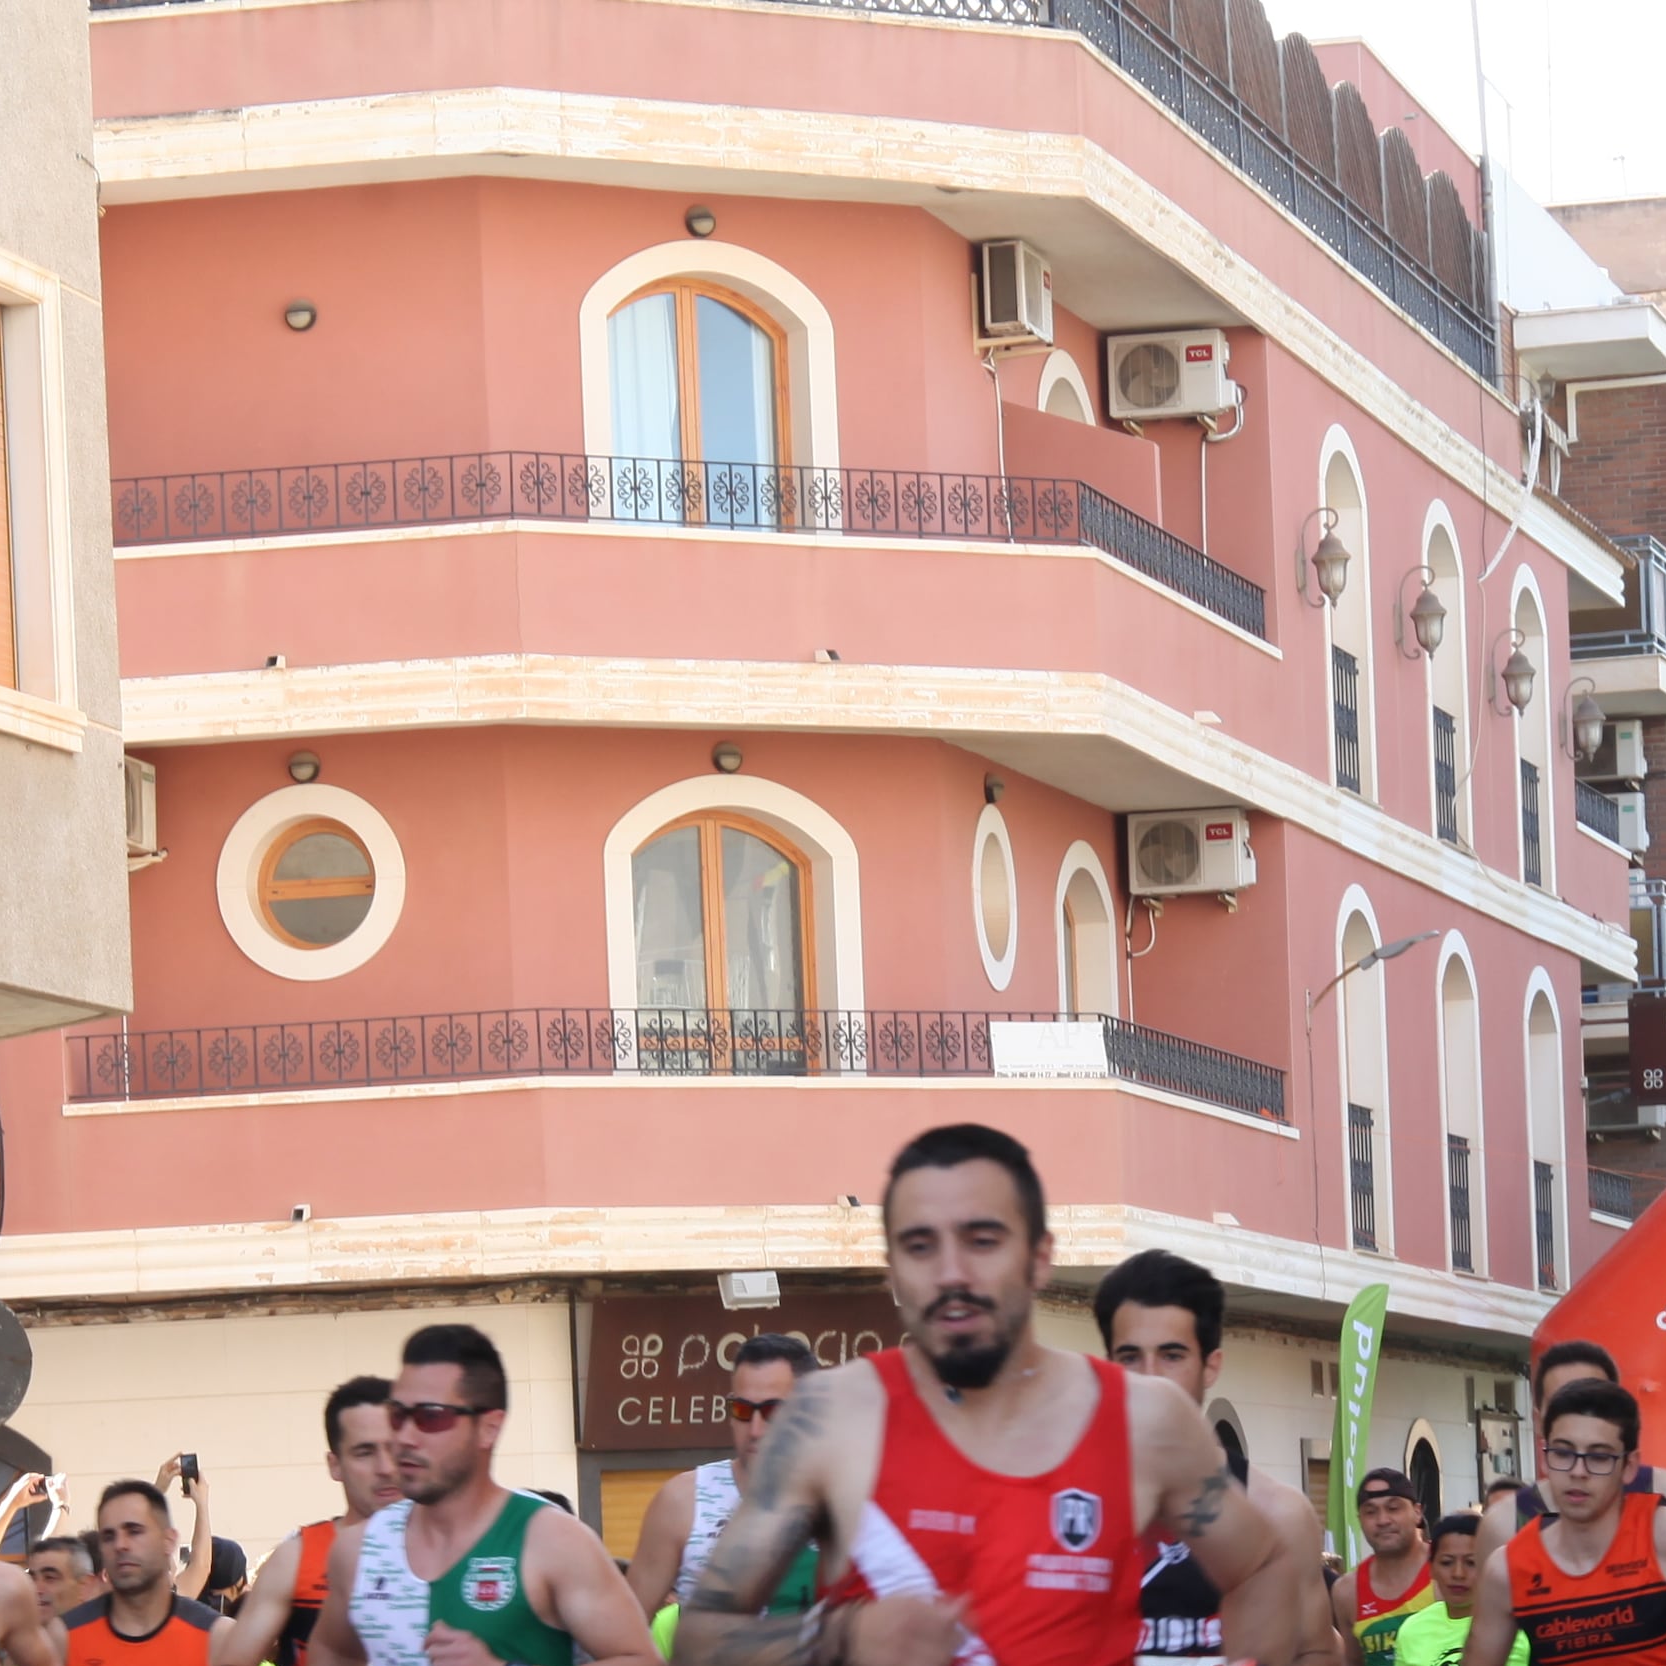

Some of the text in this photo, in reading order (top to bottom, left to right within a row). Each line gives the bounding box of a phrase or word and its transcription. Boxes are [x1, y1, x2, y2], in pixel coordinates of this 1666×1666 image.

[1189, 349, 1209, 358] TCL
[1209, 828, 1230, 836] TCL
[618, 1395, 727, 1426] CELEB
[1535, 1604, 1635, 1639] cableworld
[1363, 1630, 1396, 1654] BIK
[1556, 1632, 1614, 1651] FIBRA
